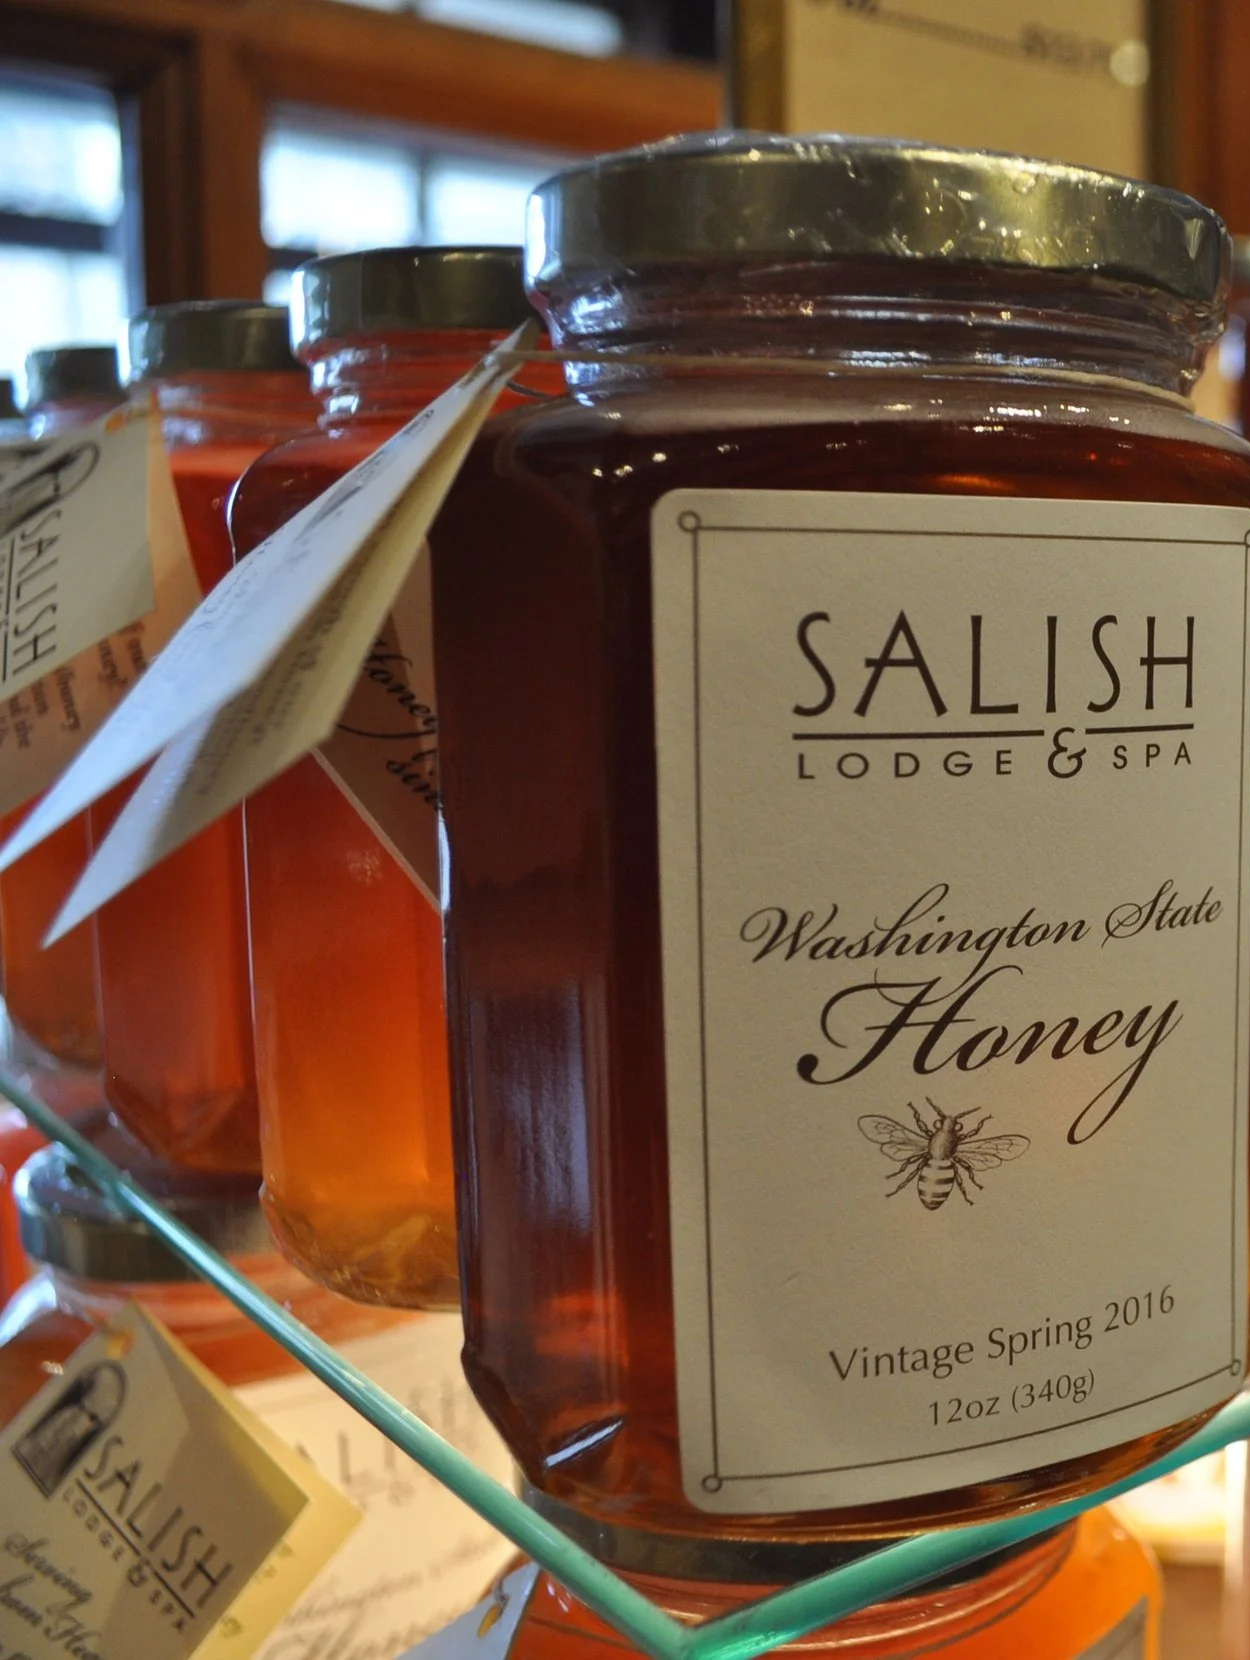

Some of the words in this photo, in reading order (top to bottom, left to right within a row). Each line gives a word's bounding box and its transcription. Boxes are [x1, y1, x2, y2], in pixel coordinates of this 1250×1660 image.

[12, 509, 62, 677] SALISH
[792, 608, 1196, 718] SALISH
[797, 749, 1013, 780] LODGE
[1047, 726, 1088, 780] &
[1112, 740, 1192, 771] SPA
[739, 882, 1092, 1007] Washington
[1103, 878, 1224, 949] State
[796, 964, 1184, 1146] Honey
[828, 1339, 975, 1382] Vintage
[986, 1314, 1094, 1366] Spring
[1103, 1284, 1176, 1334] 2016
[929, 1391, 1001, 1427] 12oz
[1010, 1367, 1097, 1414] (340g)
[83, 1434, 234, 1609] SALISH
